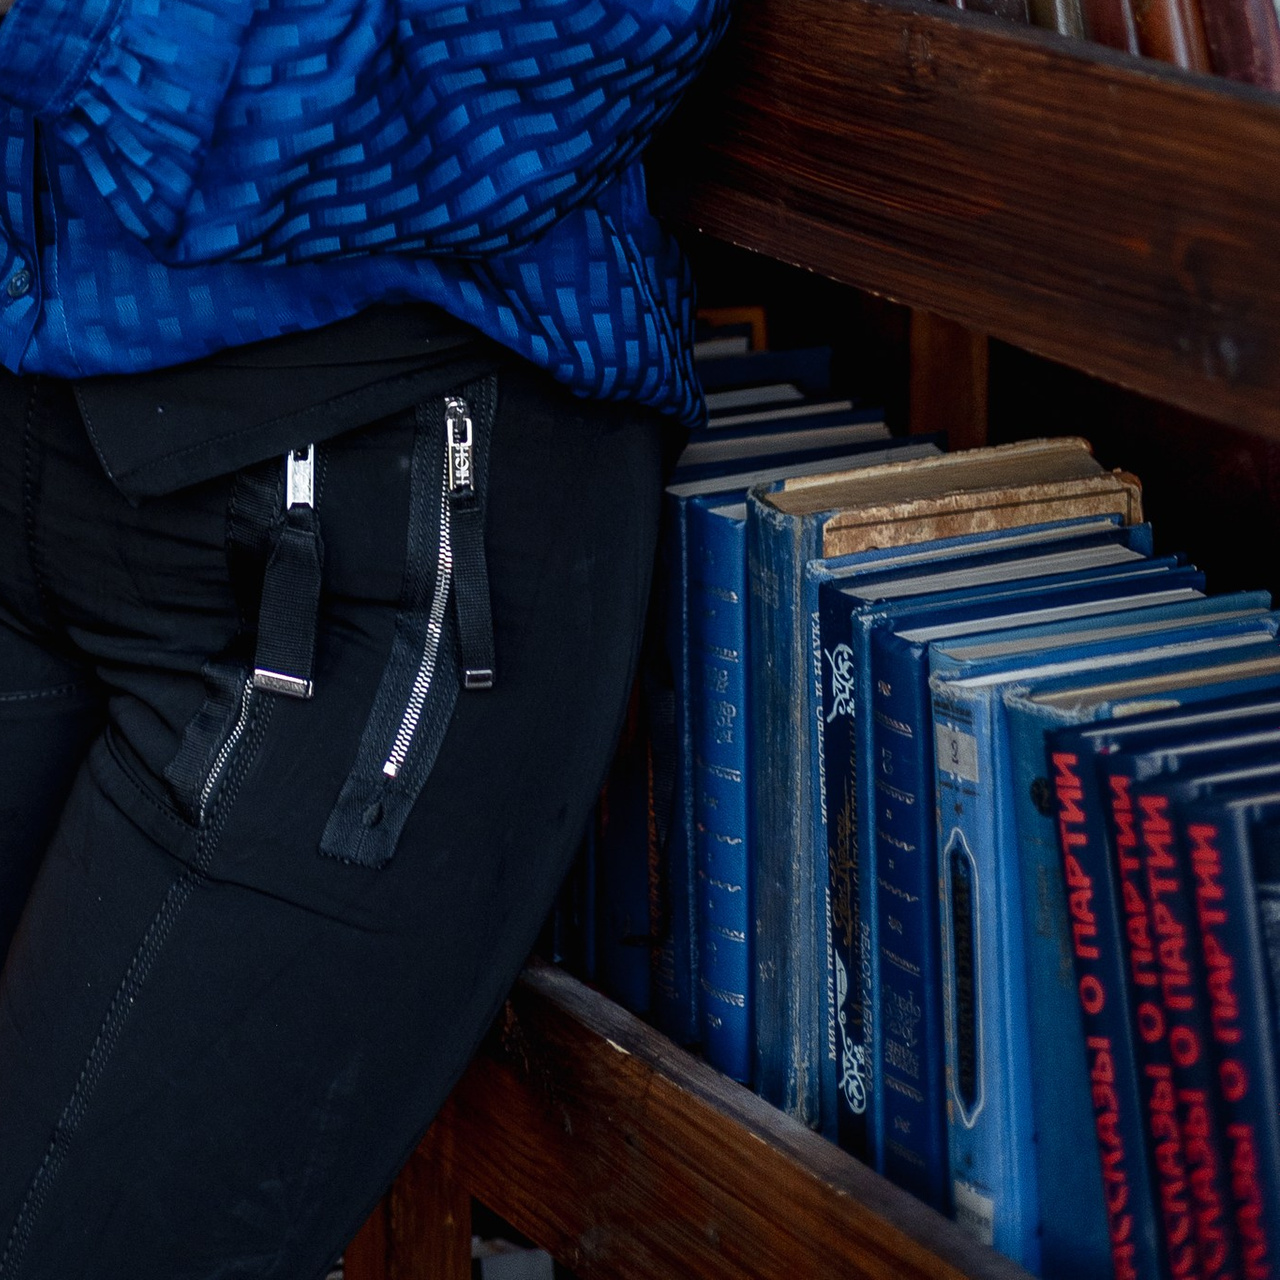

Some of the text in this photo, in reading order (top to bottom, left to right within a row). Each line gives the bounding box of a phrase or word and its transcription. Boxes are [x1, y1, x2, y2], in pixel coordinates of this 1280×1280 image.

[810, 611, 822, 676] НАУКА
[1051, 752, 1100, 960] ПАРТИИ
[1109, 774, 1158, 987] ПАРТИИ
[1138, 795, 1195, 1011] ПАРТИИ
[1188, 822, 1241, 1044] ПАРТИИ
[826, 975, 838, 1061] МИХАИЛ
[1080, 974, 1107, 1015] О
[1137, 1002, 1166, 1043] О
[1171, 1025, 1200, 1067] О
[1220, 1057, 1249, 1102] О
